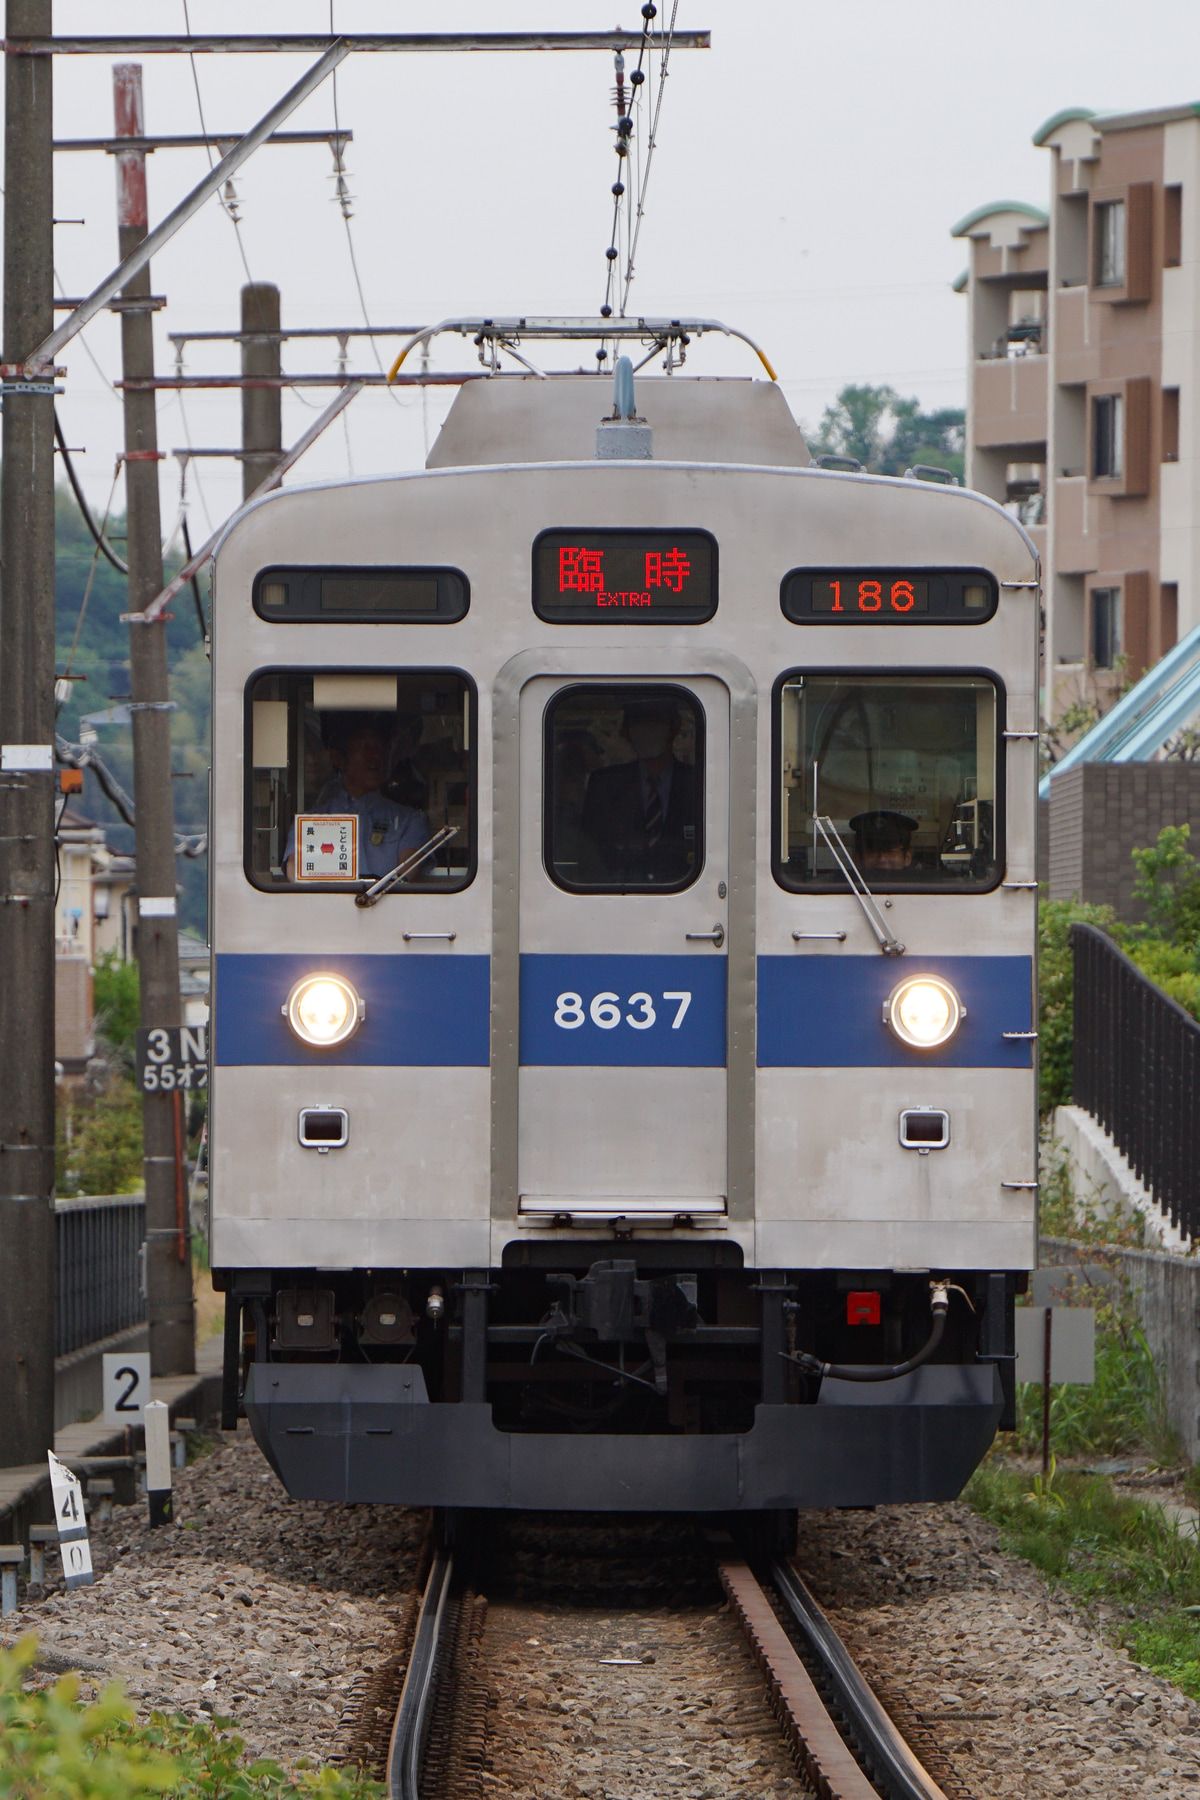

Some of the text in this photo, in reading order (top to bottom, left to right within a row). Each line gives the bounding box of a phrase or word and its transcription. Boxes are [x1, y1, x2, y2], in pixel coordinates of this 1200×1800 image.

[597, 592, 651, 607] EXTRA
[829, 581, 914, 612] 186
[339, 826, 348, 871] こどもの国
[554, 991, 692, 1030] 8637
[114, 1366, 139, 1412] 2
[61, 1489, 79, 1522] 4
[70, 1545, 83, 1571] 0
